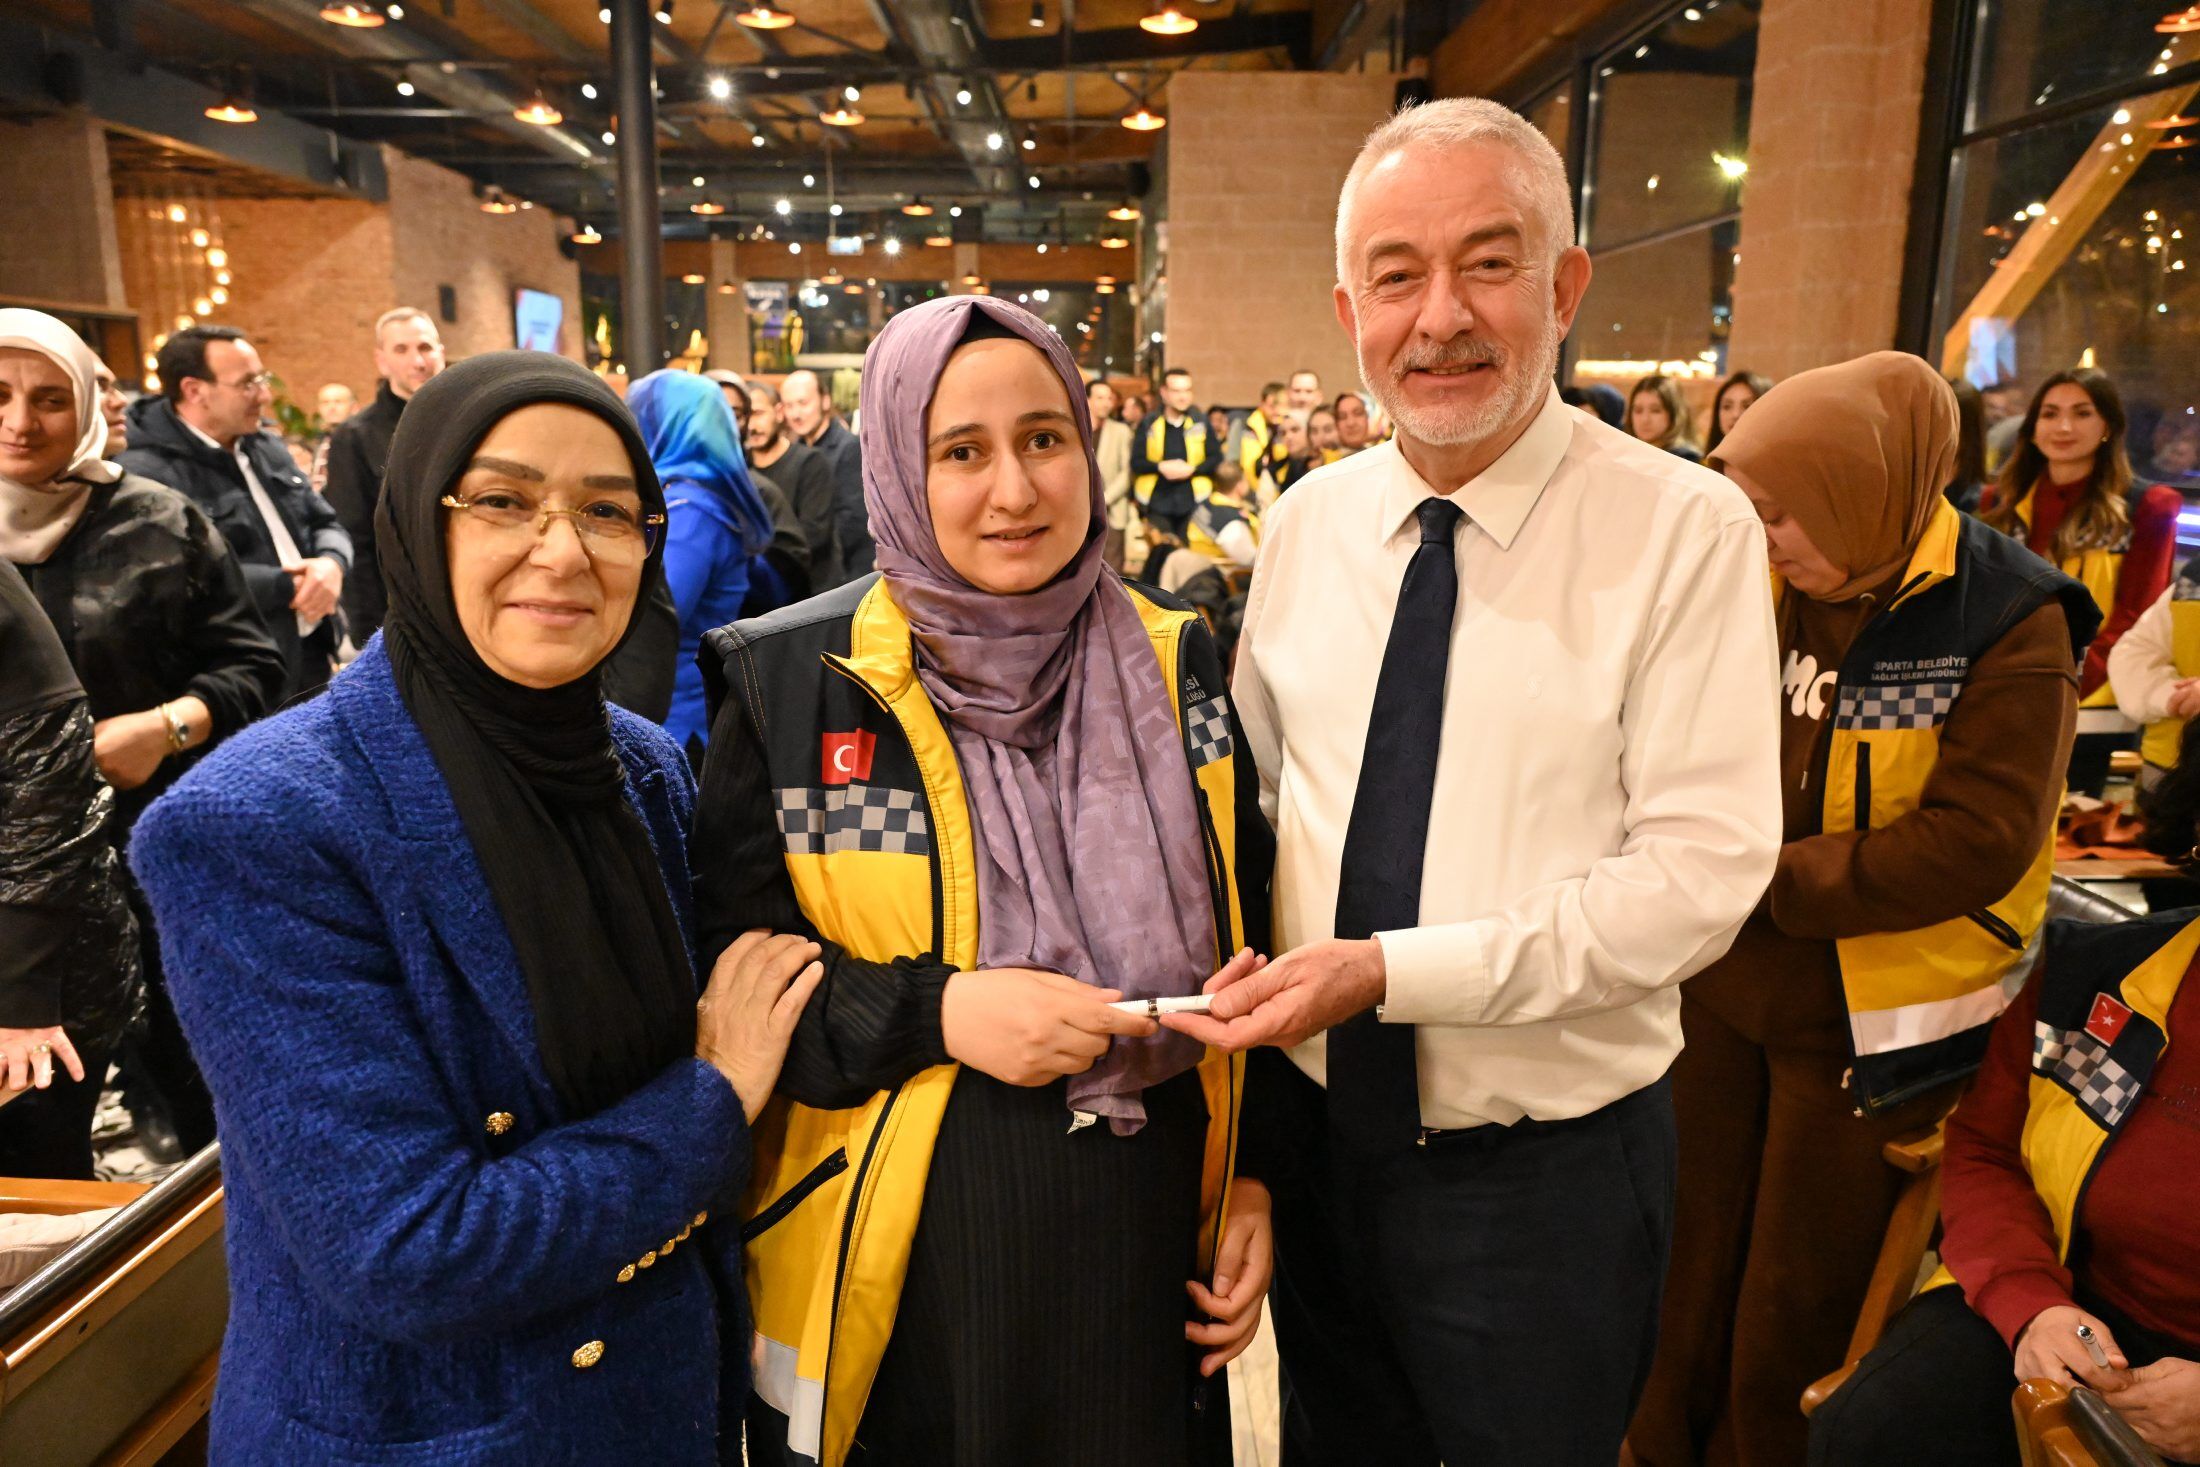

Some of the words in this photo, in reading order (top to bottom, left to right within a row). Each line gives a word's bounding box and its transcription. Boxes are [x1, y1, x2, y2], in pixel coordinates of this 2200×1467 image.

[1872, 660, 1914, 671] SPARTA
[1916, 655, 1969, 669] BELEDİYE
[1926, 668, 1967, 679] MÜDÜRLÜ
[1186, 689, 1206, 703] LÜĞÜ
